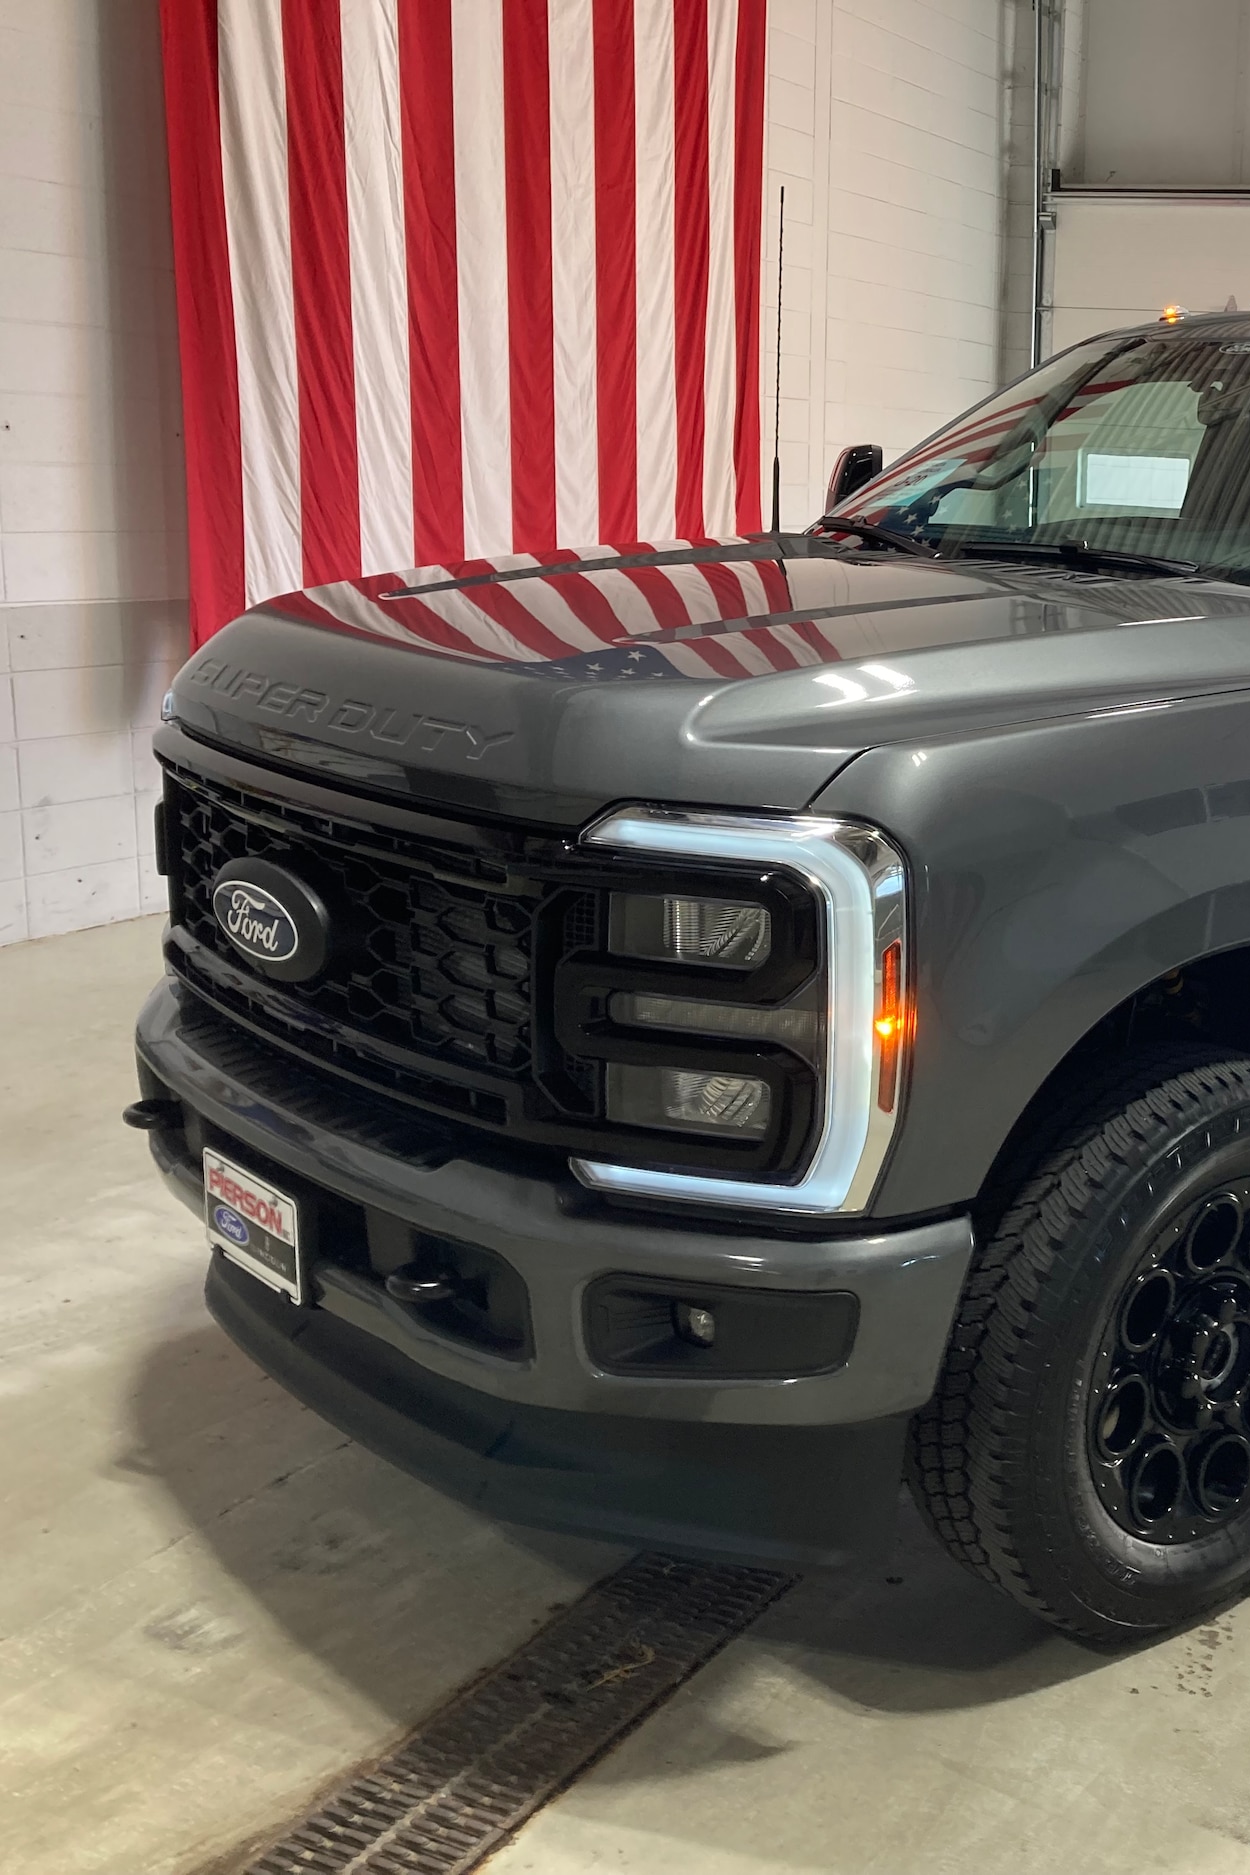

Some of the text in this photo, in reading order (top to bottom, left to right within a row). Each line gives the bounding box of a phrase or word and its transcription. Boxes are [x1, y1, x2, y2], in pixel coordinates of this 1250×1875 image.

[190, 657, 515, 760] SUPER DUTY
[227, 889, 281, 952] Ford
[208, 1167, 283, 1236] PIERSON
[220, 1209, 243, 1241] Ford
